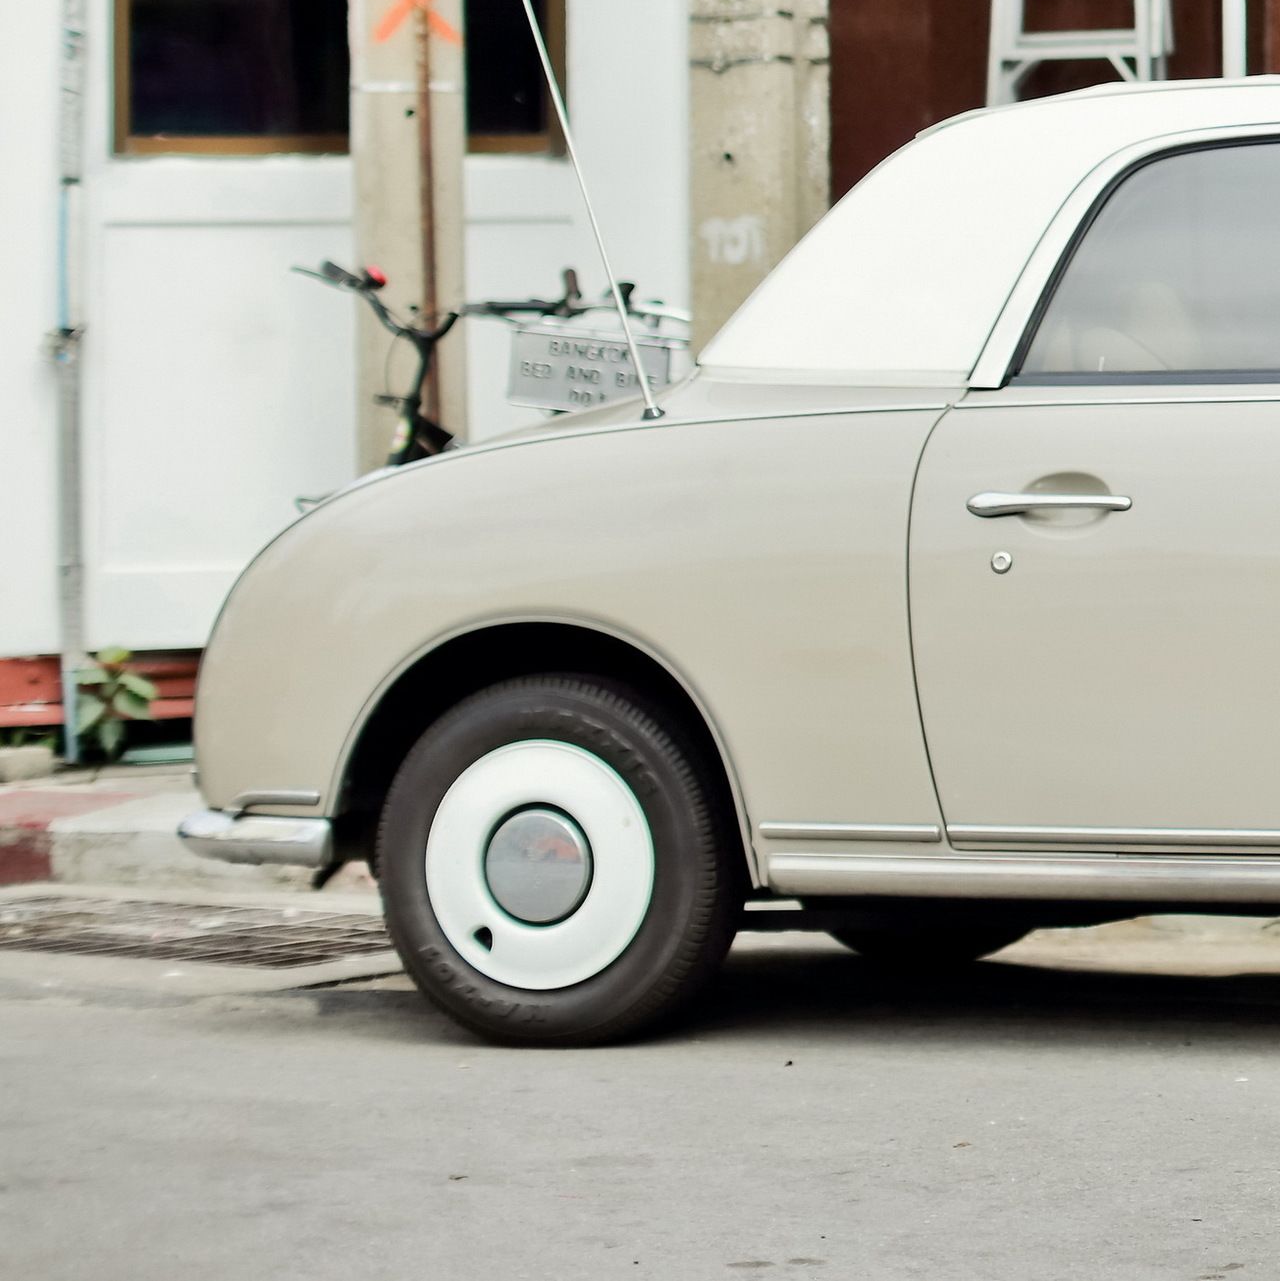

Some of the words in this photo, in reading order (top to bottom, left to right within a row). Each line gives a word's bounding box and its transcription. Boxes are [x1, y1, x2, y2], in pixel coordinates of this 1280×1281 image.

[549, 339, 629, 363] BANGKOK
[520, 360, 552, 379] BED
[565, 365, 601, 385] AND
